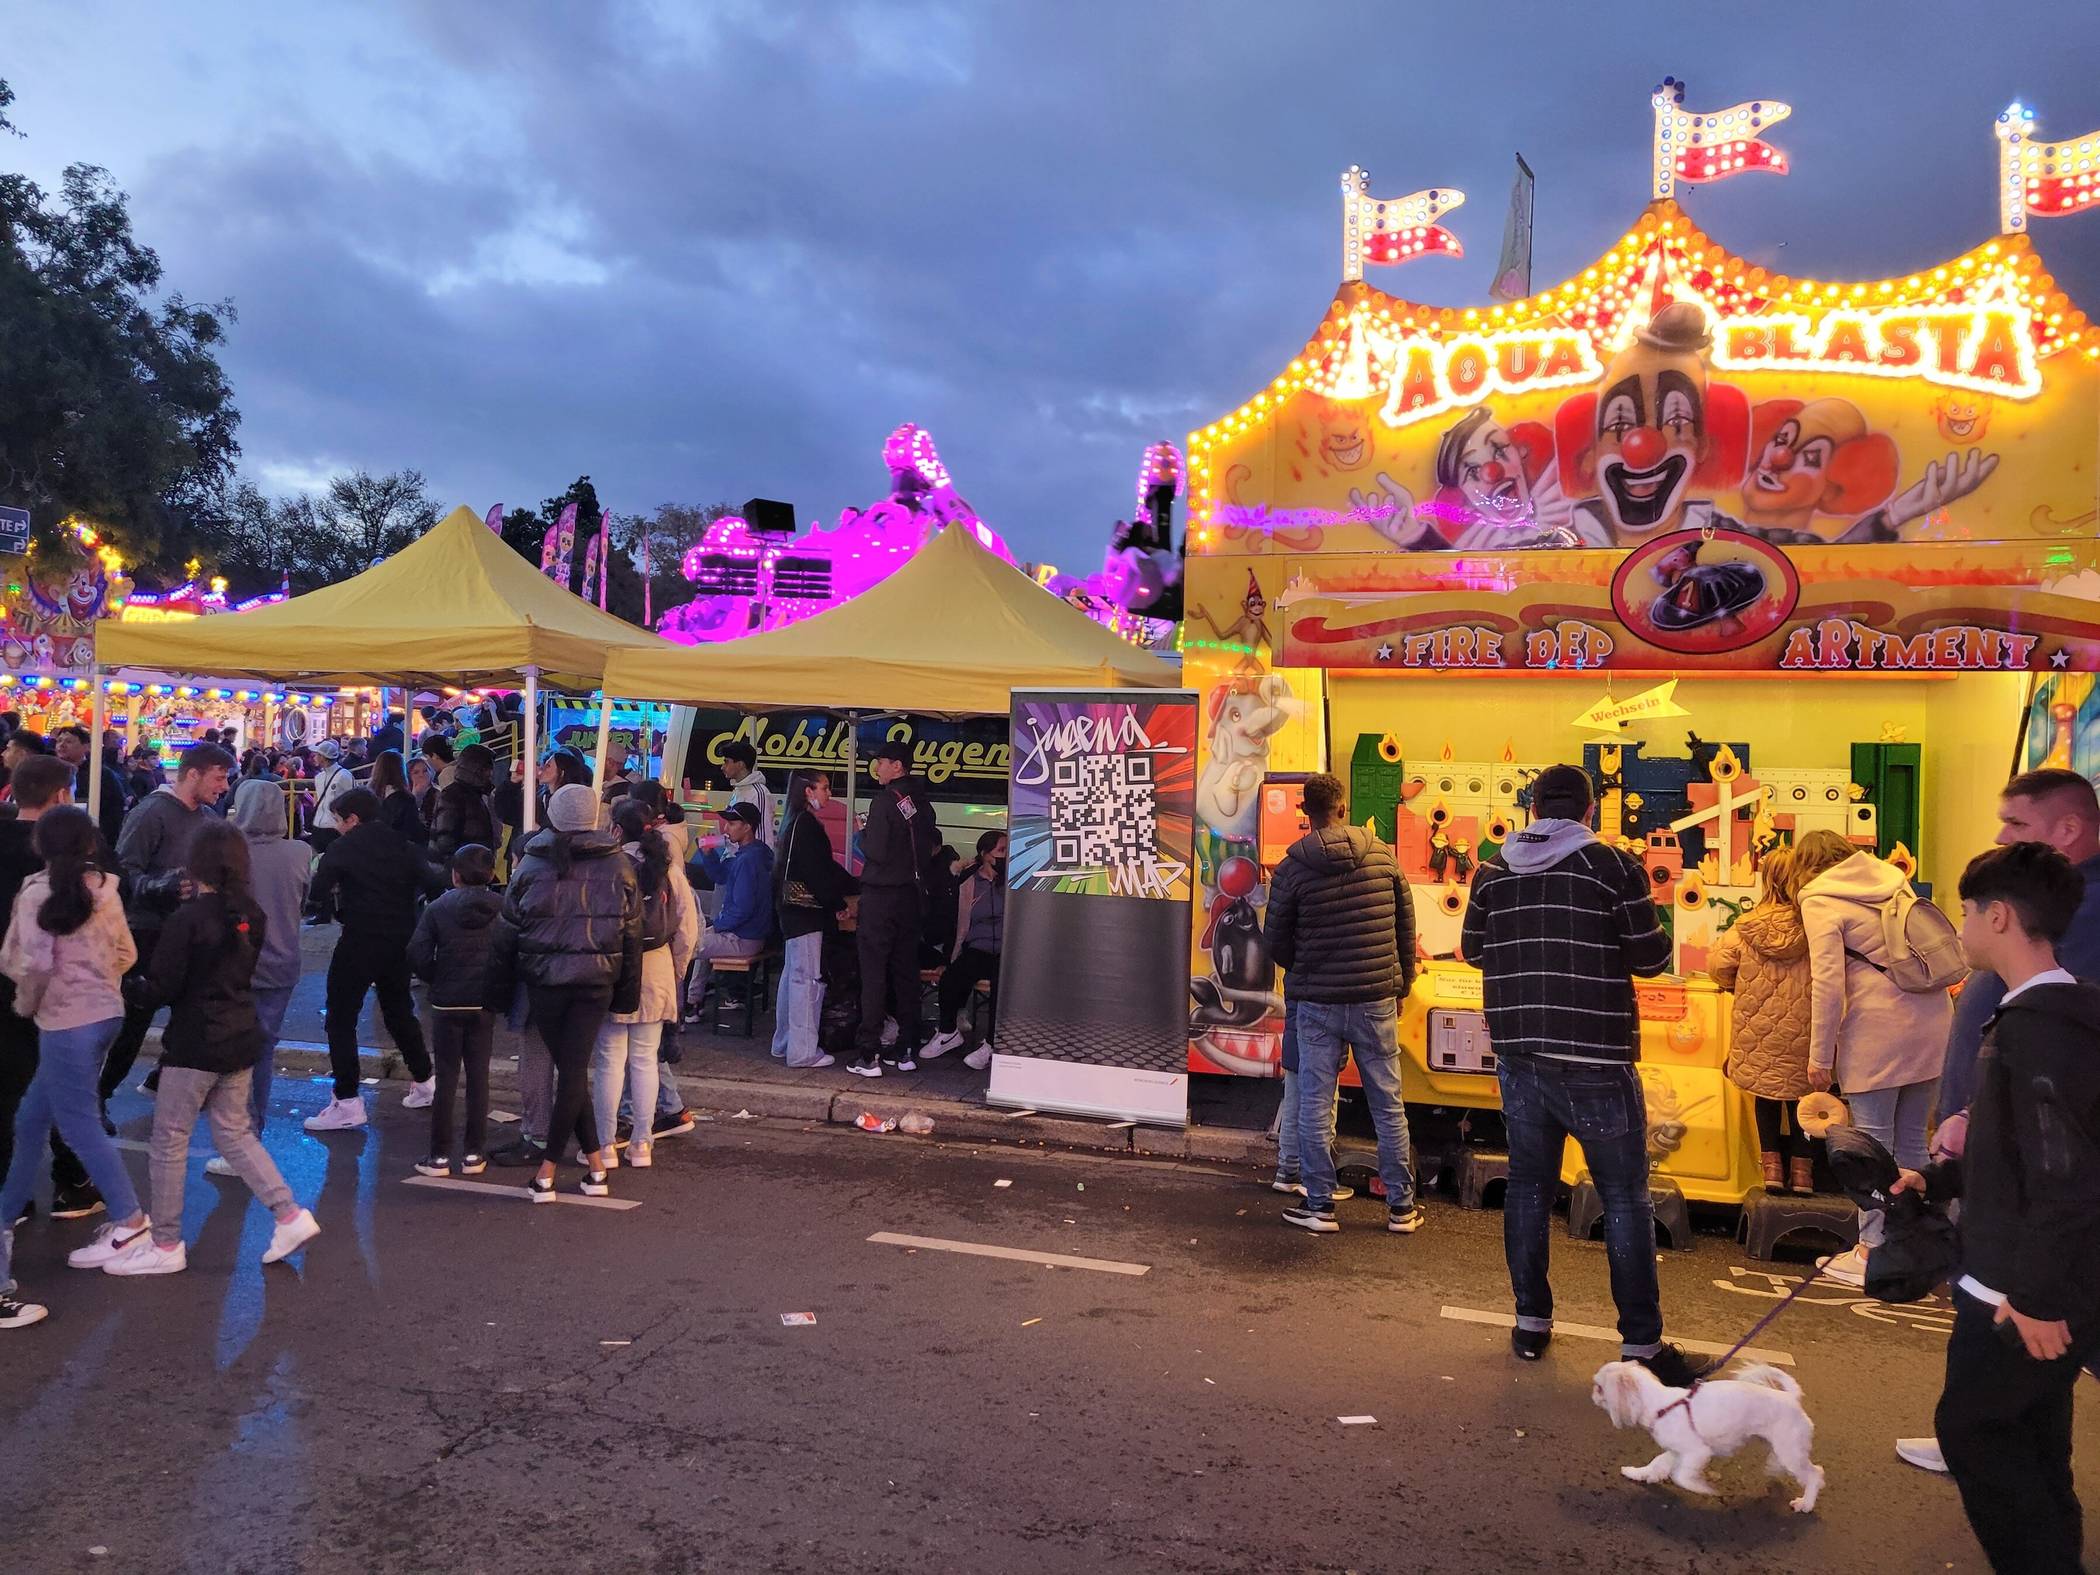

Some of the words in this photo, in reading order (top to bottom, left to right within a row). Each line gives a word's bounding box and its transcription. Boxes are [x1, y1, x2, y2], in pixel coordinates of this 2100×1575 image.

[1385, 331, 1599, 423] AQUA
[1716, 304, 2038, 395] BLASTA
[1403, 626, 1505, 668] FIRE
[1525, 620, 1614, 668] DEP
[1780, 618, 2040, 670] ARTMENT
[1590, 696, 1661, 723] Wechseln
[706, 715, 859, 766] Mobile
[1015, 704, 1152, 785] jugend
